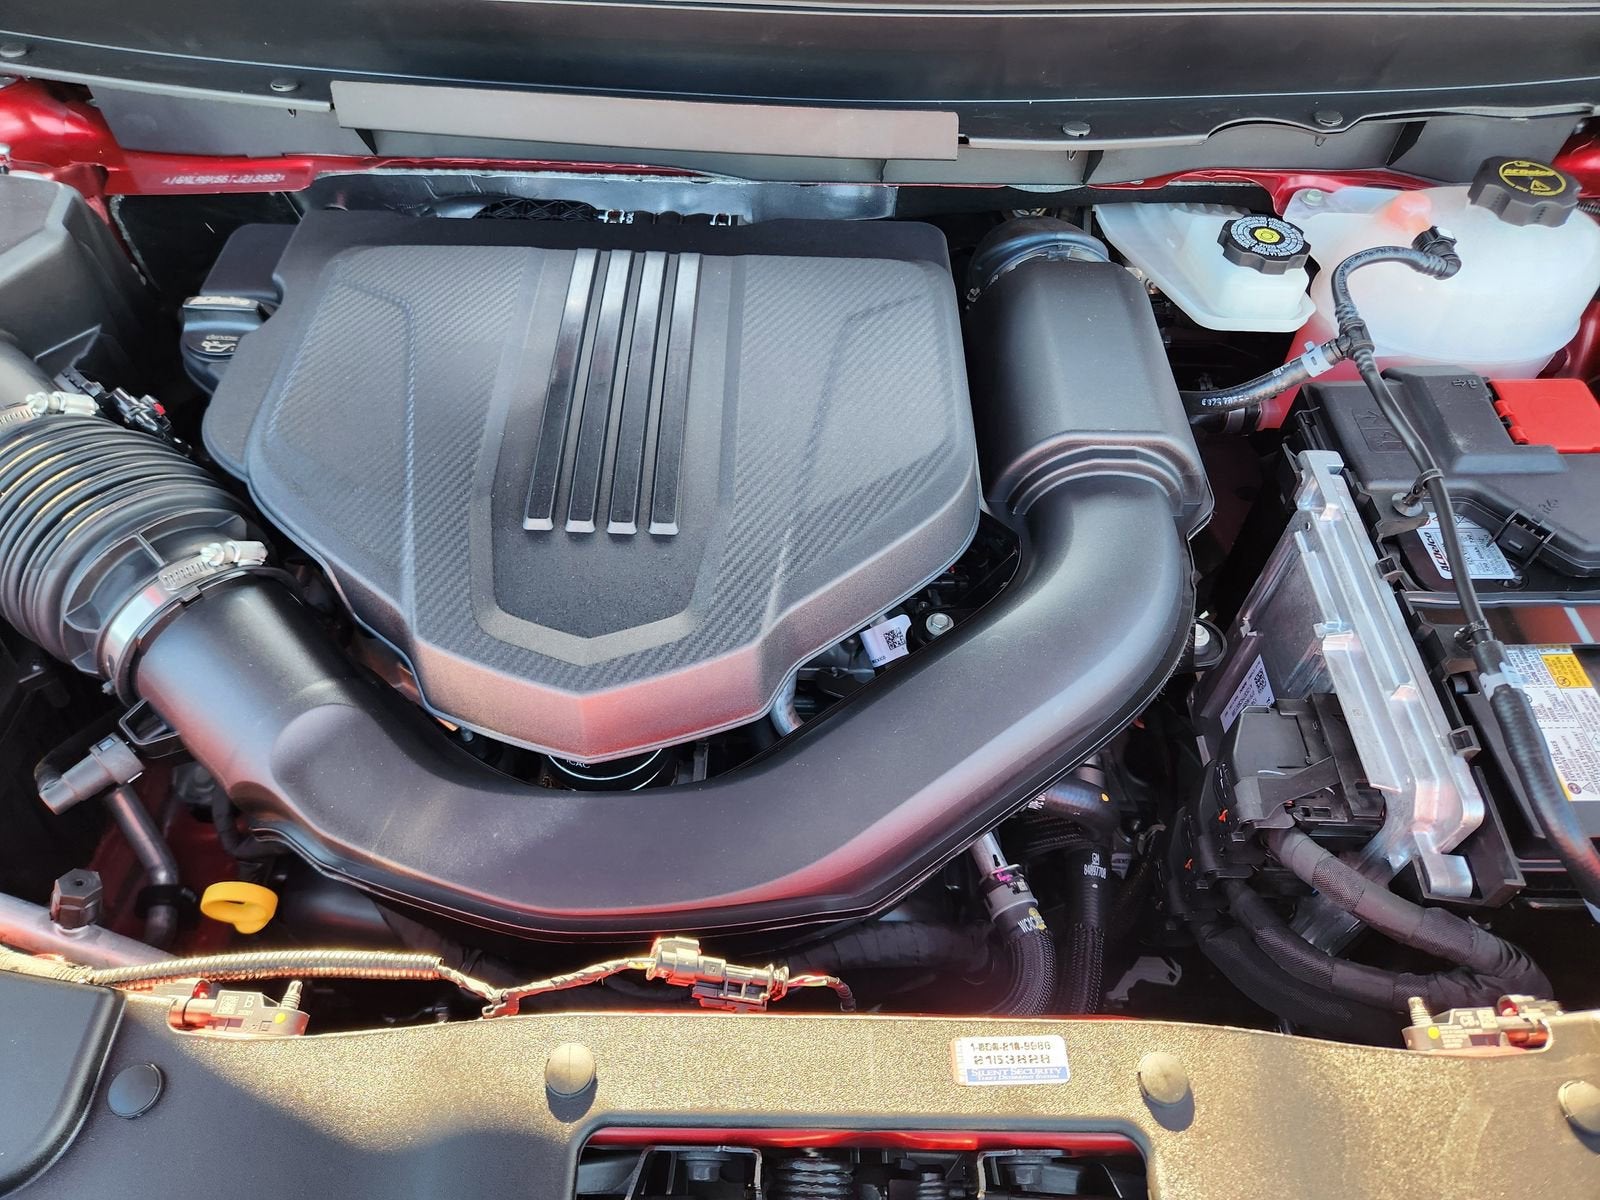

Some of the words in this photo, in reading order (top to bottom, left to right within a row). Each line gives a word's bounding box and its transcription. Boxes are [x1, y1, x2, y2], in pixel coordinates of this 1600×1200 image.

[1423, 531, 1451, 572] ACDelco
[971, 1069, 1010, 1077] SILENT
[1011, 1067, 1063, 1076] SECURITY
